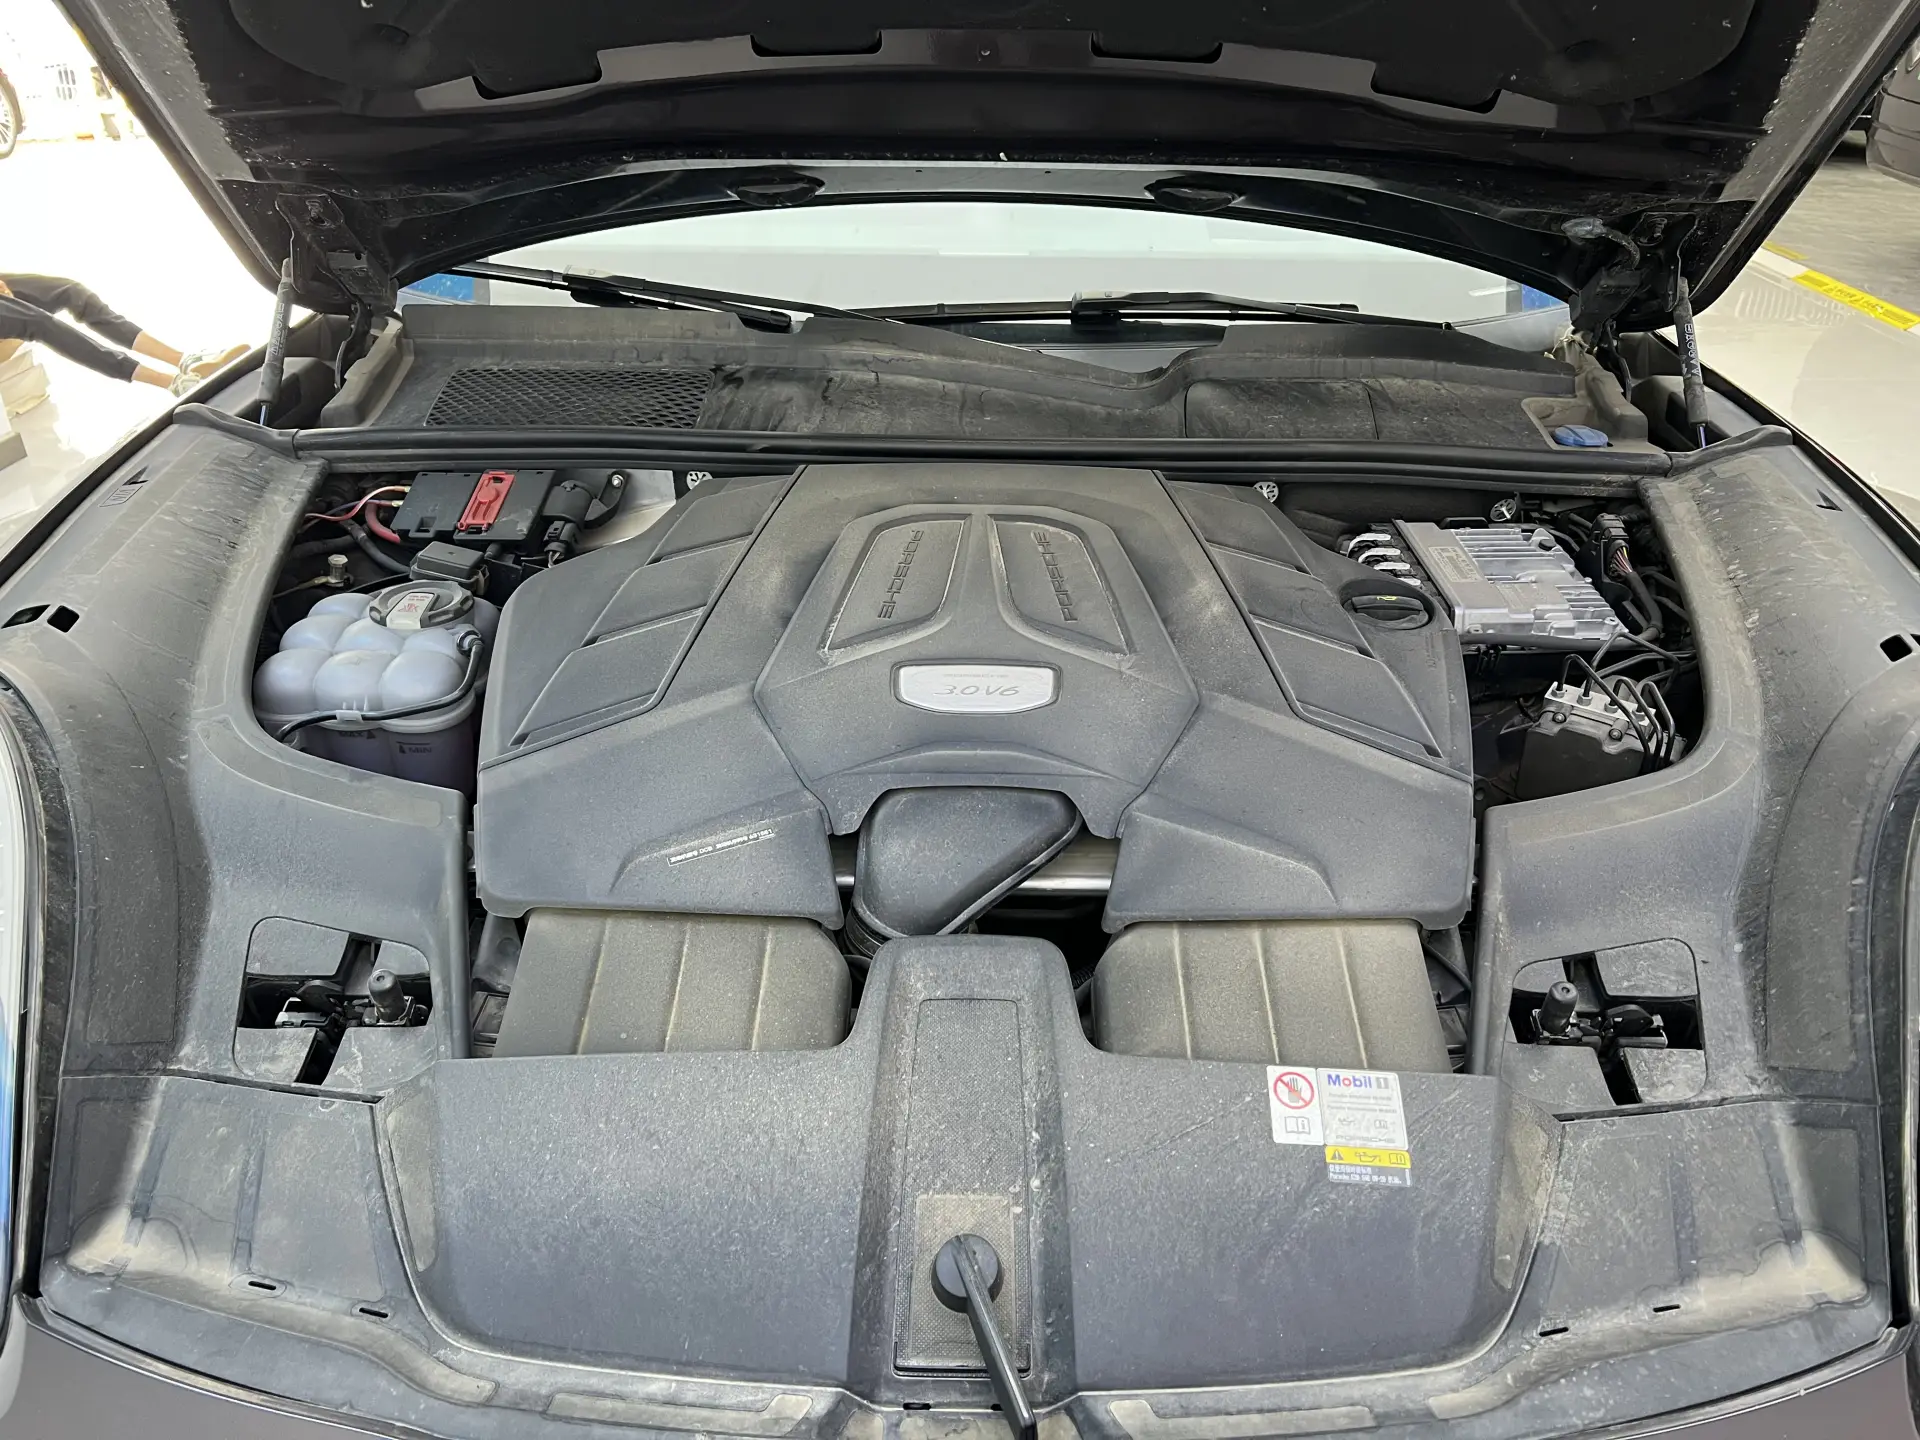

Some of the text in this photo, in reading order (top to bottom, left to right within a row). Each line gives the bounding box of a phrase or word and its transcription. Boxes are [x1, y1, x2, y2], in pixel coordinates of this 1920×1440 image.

[877, 529, 925, 620] PORSCHE
[1031, 530, 1078, 622] PORSCHE
[1327, 1073, 1373, 1089] Mobil
